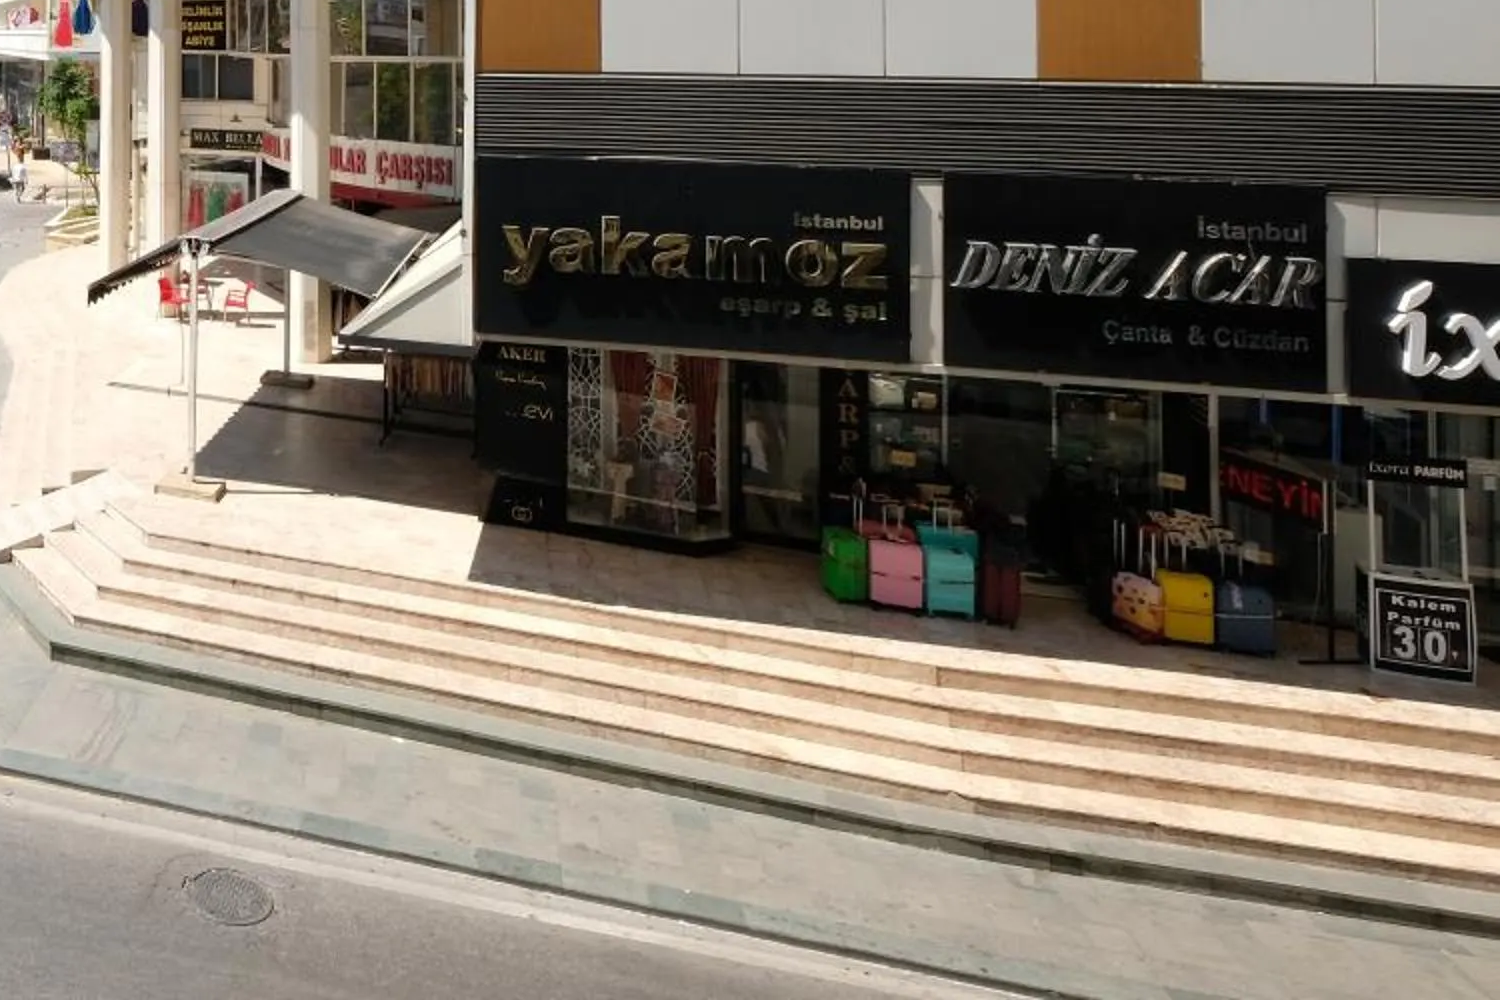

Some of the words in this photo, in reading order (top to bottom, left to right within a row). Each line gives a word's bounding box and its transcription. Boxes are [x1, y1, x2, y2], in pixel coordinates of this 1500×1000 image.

[376, 149, 453, 189] ÇARŞISI
[502, 215, 888, 289] yakamoz
[949, 233, 1138, 297] DENİZ
[1144, 250, 1323, 309] ACAR
[720, 298, 800, 318] eşarp
[812, 299, 833, 319] &
[843, 303, 888, 323] şal
[1103, 320, 1173, 345] Çanta
[1188, 325, 1206, 346] &
[1213, 326, 1310, 352] Cüzdan
[1413, 465, 1465, 481] PARFÜM
[1391, 595, 1457, 613] Kalem
[1387, 611, 1461, 631] Parfüm
[1392, 625, 1448, 664] 30
